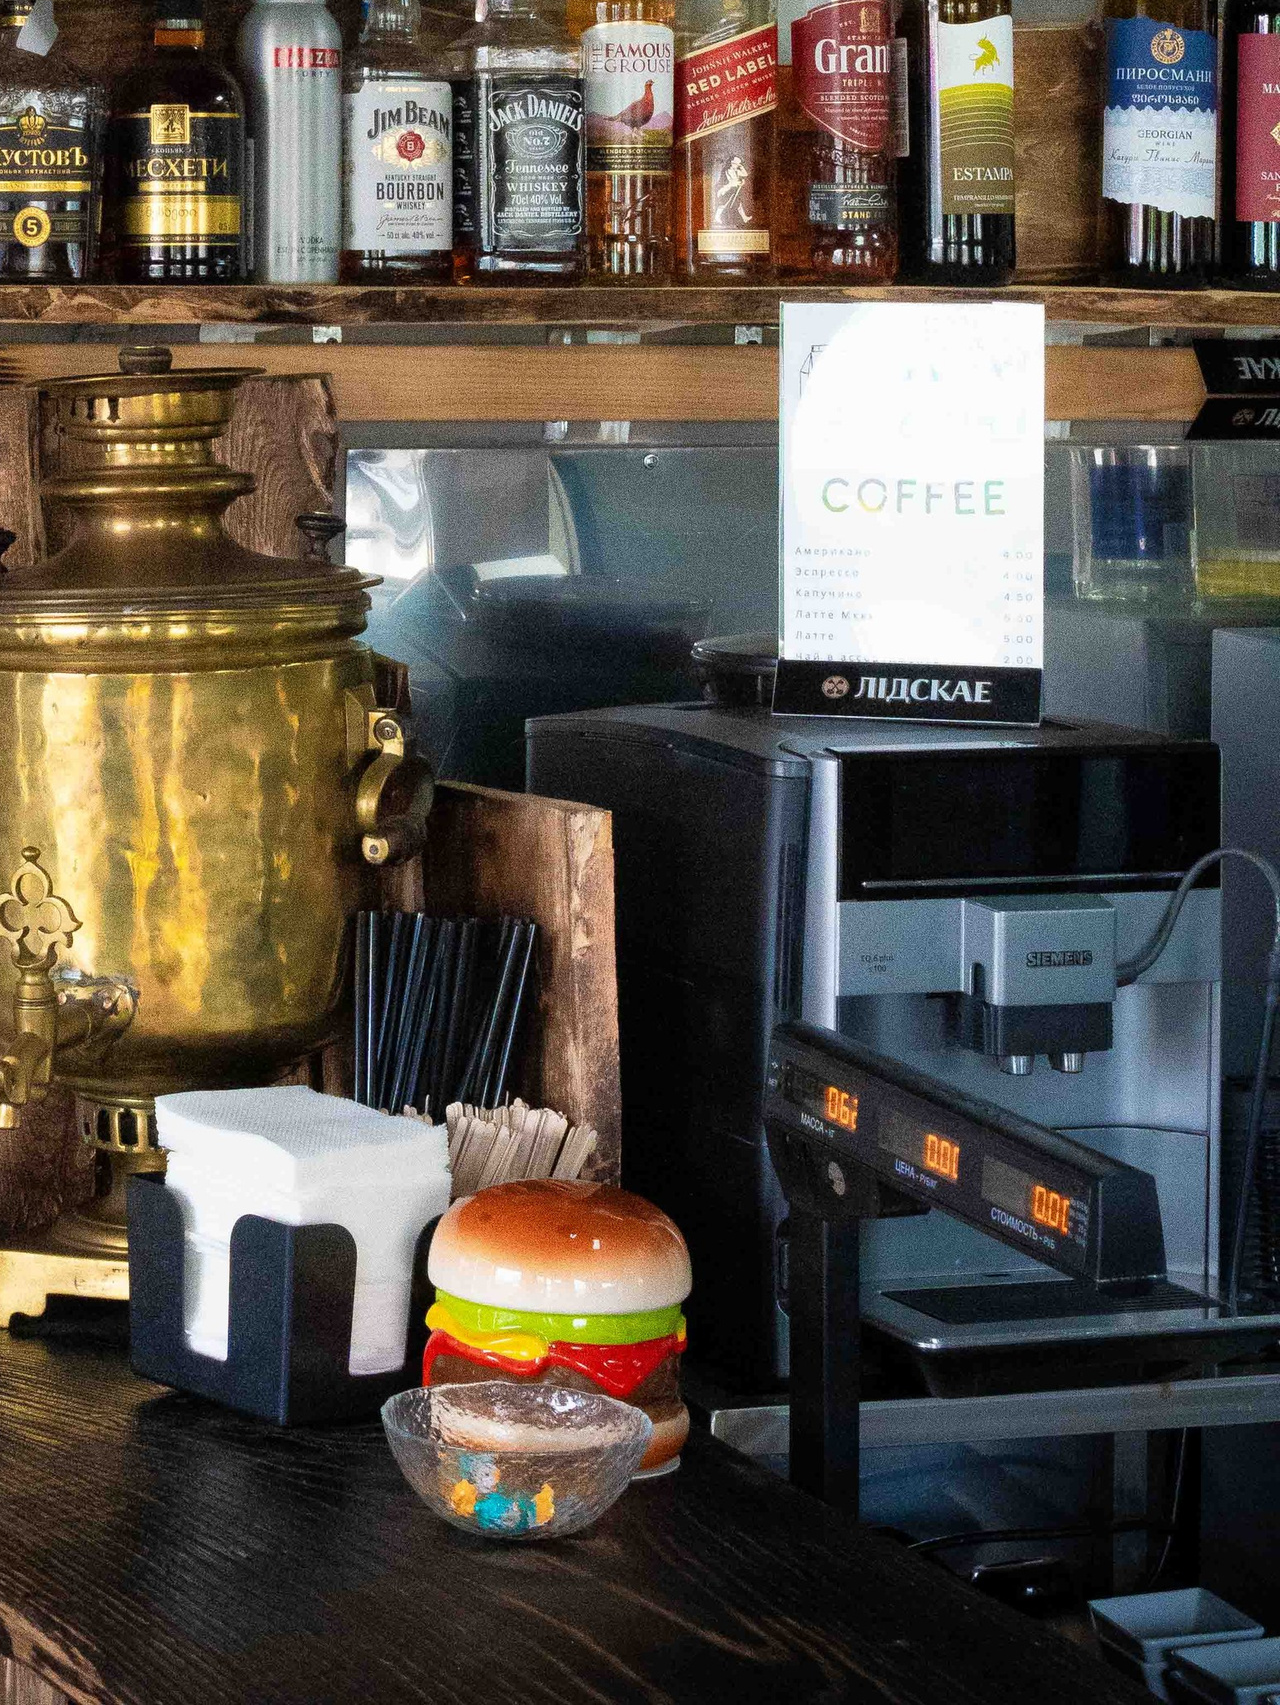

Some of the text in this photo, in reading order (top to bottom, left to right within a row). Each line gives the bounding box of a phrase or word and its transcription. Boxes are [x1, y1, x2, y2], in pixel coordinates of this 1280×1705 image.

[592, 43, 603, 71] THE
[605, 42, 671, 58] FAMOUS
[814, 38, 889, 74] Gran
[604, 58, 671, 73] GROUSE
[692, 55, 731, 78] JOHNNIE
[686, 53, 776, 96] RED LABEL
[1116, 67, 1212, 83] ПИРОСМАНИ
[687, 93, 720, 110] BLENDED
[820, 94, 857, 102] BLENDED
[367, 100, 452, 141] JIM BEAM
[488, 94, 584, 132] JACK DANIEL'S
[1137, 129, 1193, 140] GEORGIAN
[505, 159, 570, 174] Tennessee
[953, 167, 1014, 181] ESTAMPA
[384, 174, 437, 182] KENTUCKY STRAIGHT
[376, 182, 444, 201] BOURBON
[506, 182, 568, 192] WHISKEY
[396, 201, 426, 210] WHISKEY
[511, 194, 564, 205] 70cl 40% Vol.
[26, 219, 38, 236] 5
[821, 477, 1006, 516] COFFEE
[795, 546, 872, 559] Американо
[795, 567, 860, 579] Эспрессо
[795, 588, 863, 601] Капучино
[795, 609, 835, 620] Латте
[795, 630, 1033, 644] Латте 5.00
[1003, 655, 1033, 665] 2.00
[853, 676, 993, 704] ЛІДСКАЕ
[1025, 949, 1094, 968] SIEMENS
[894, 1157, 915, 1180] ЦЕНА
[990, 1206, 1038, 1241] СТОИМОСТЬ
